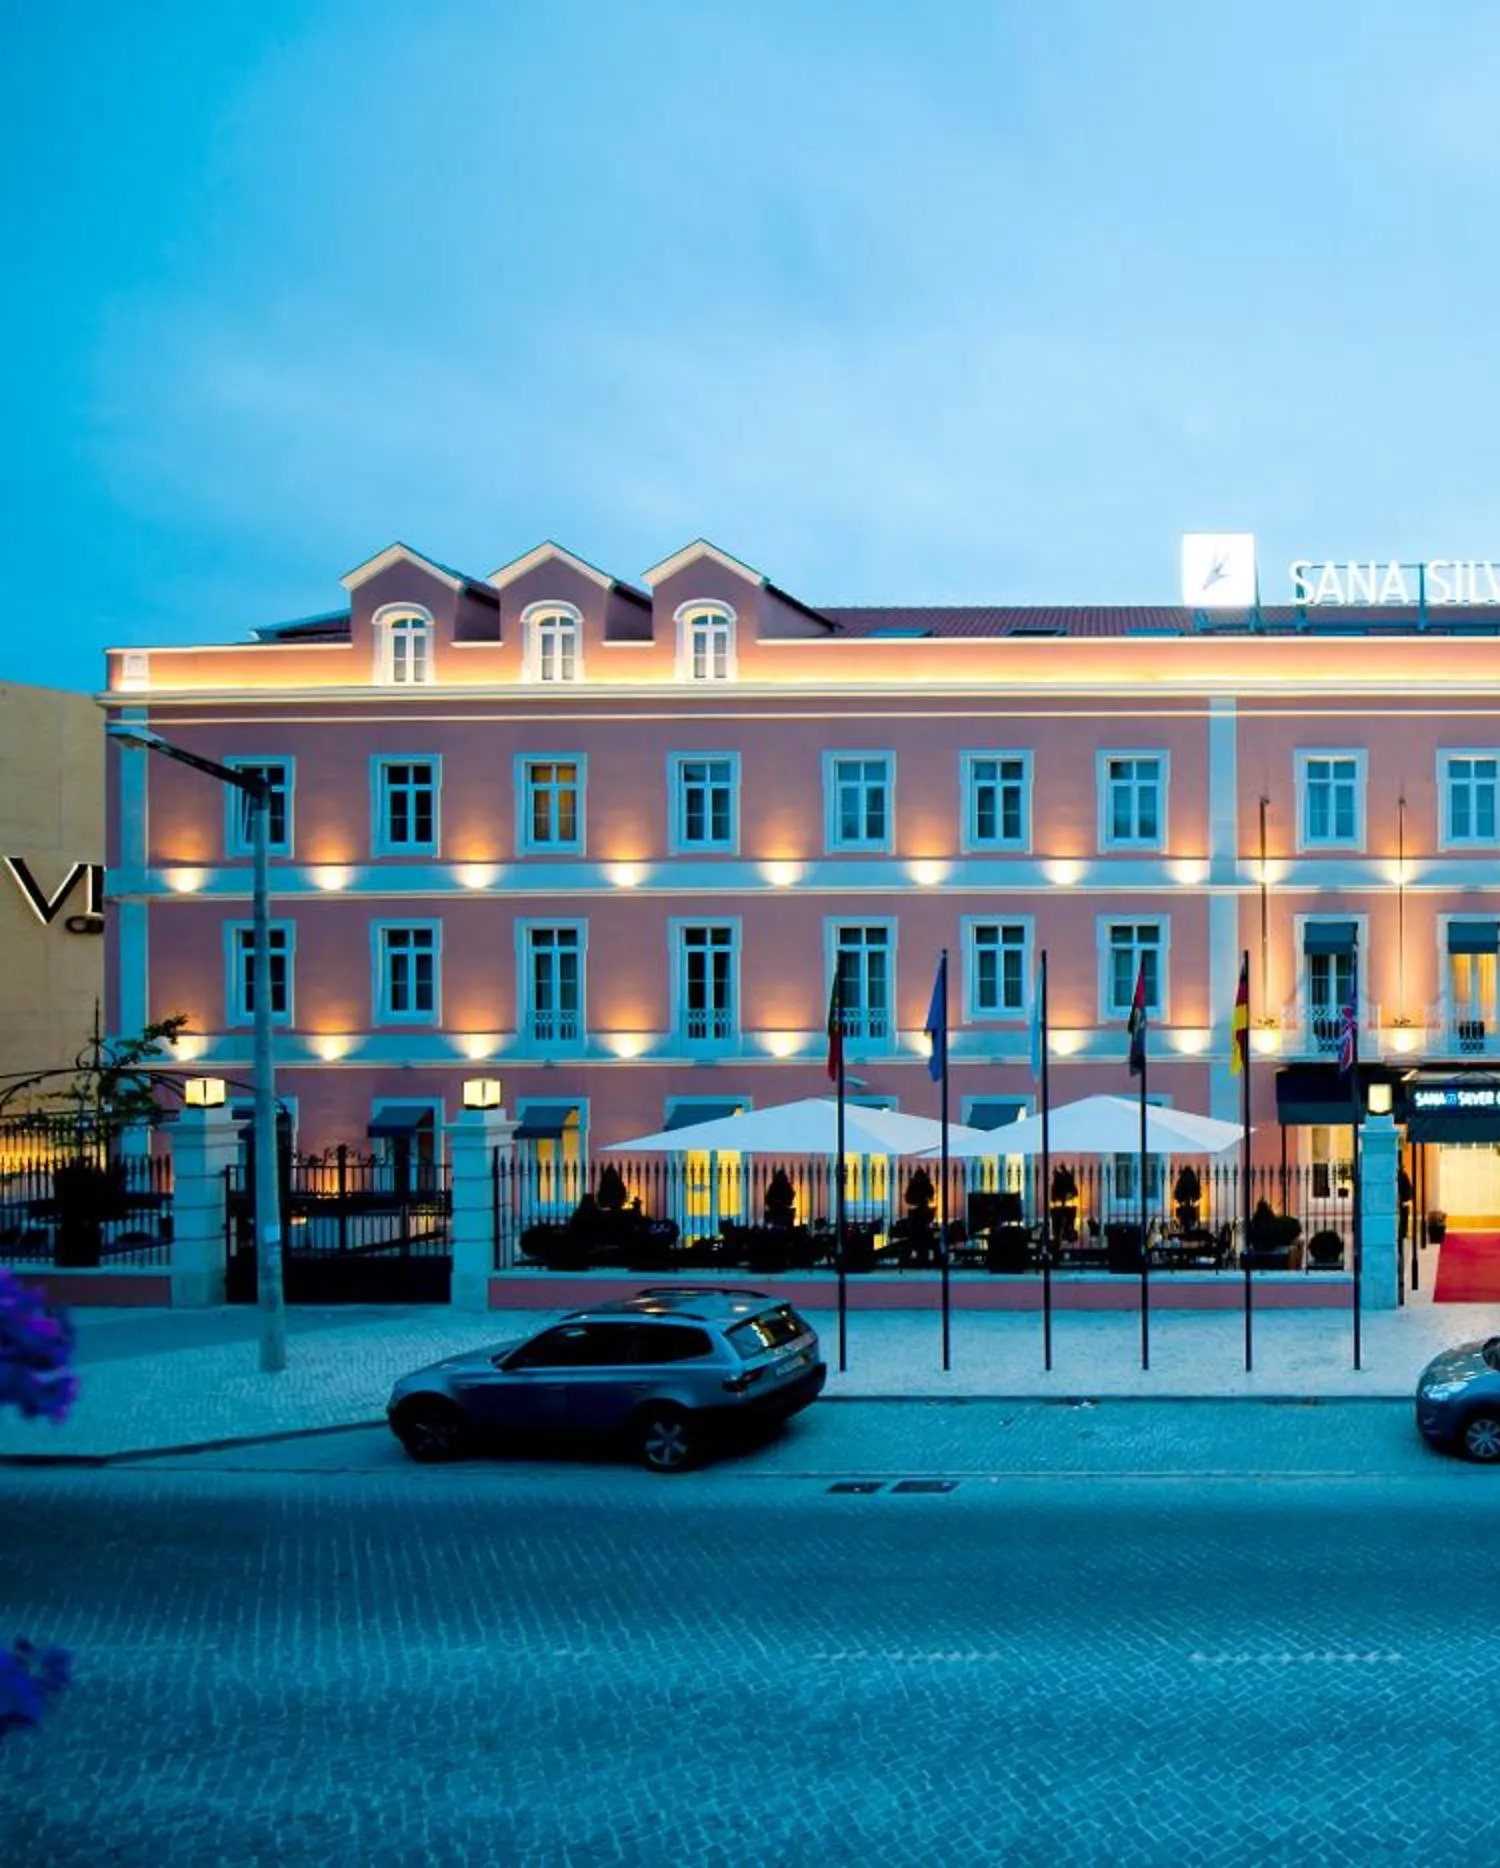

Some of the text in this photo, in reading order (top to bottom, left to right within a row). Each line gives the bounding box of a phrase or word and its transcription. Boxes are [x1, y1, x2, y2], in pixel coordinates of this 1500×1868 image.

[1289, 559, 1410, 606] SANA
[1415, 1090, 1447, 1107] SANA
[1457, 1090, 1495, 1107] SILVER
